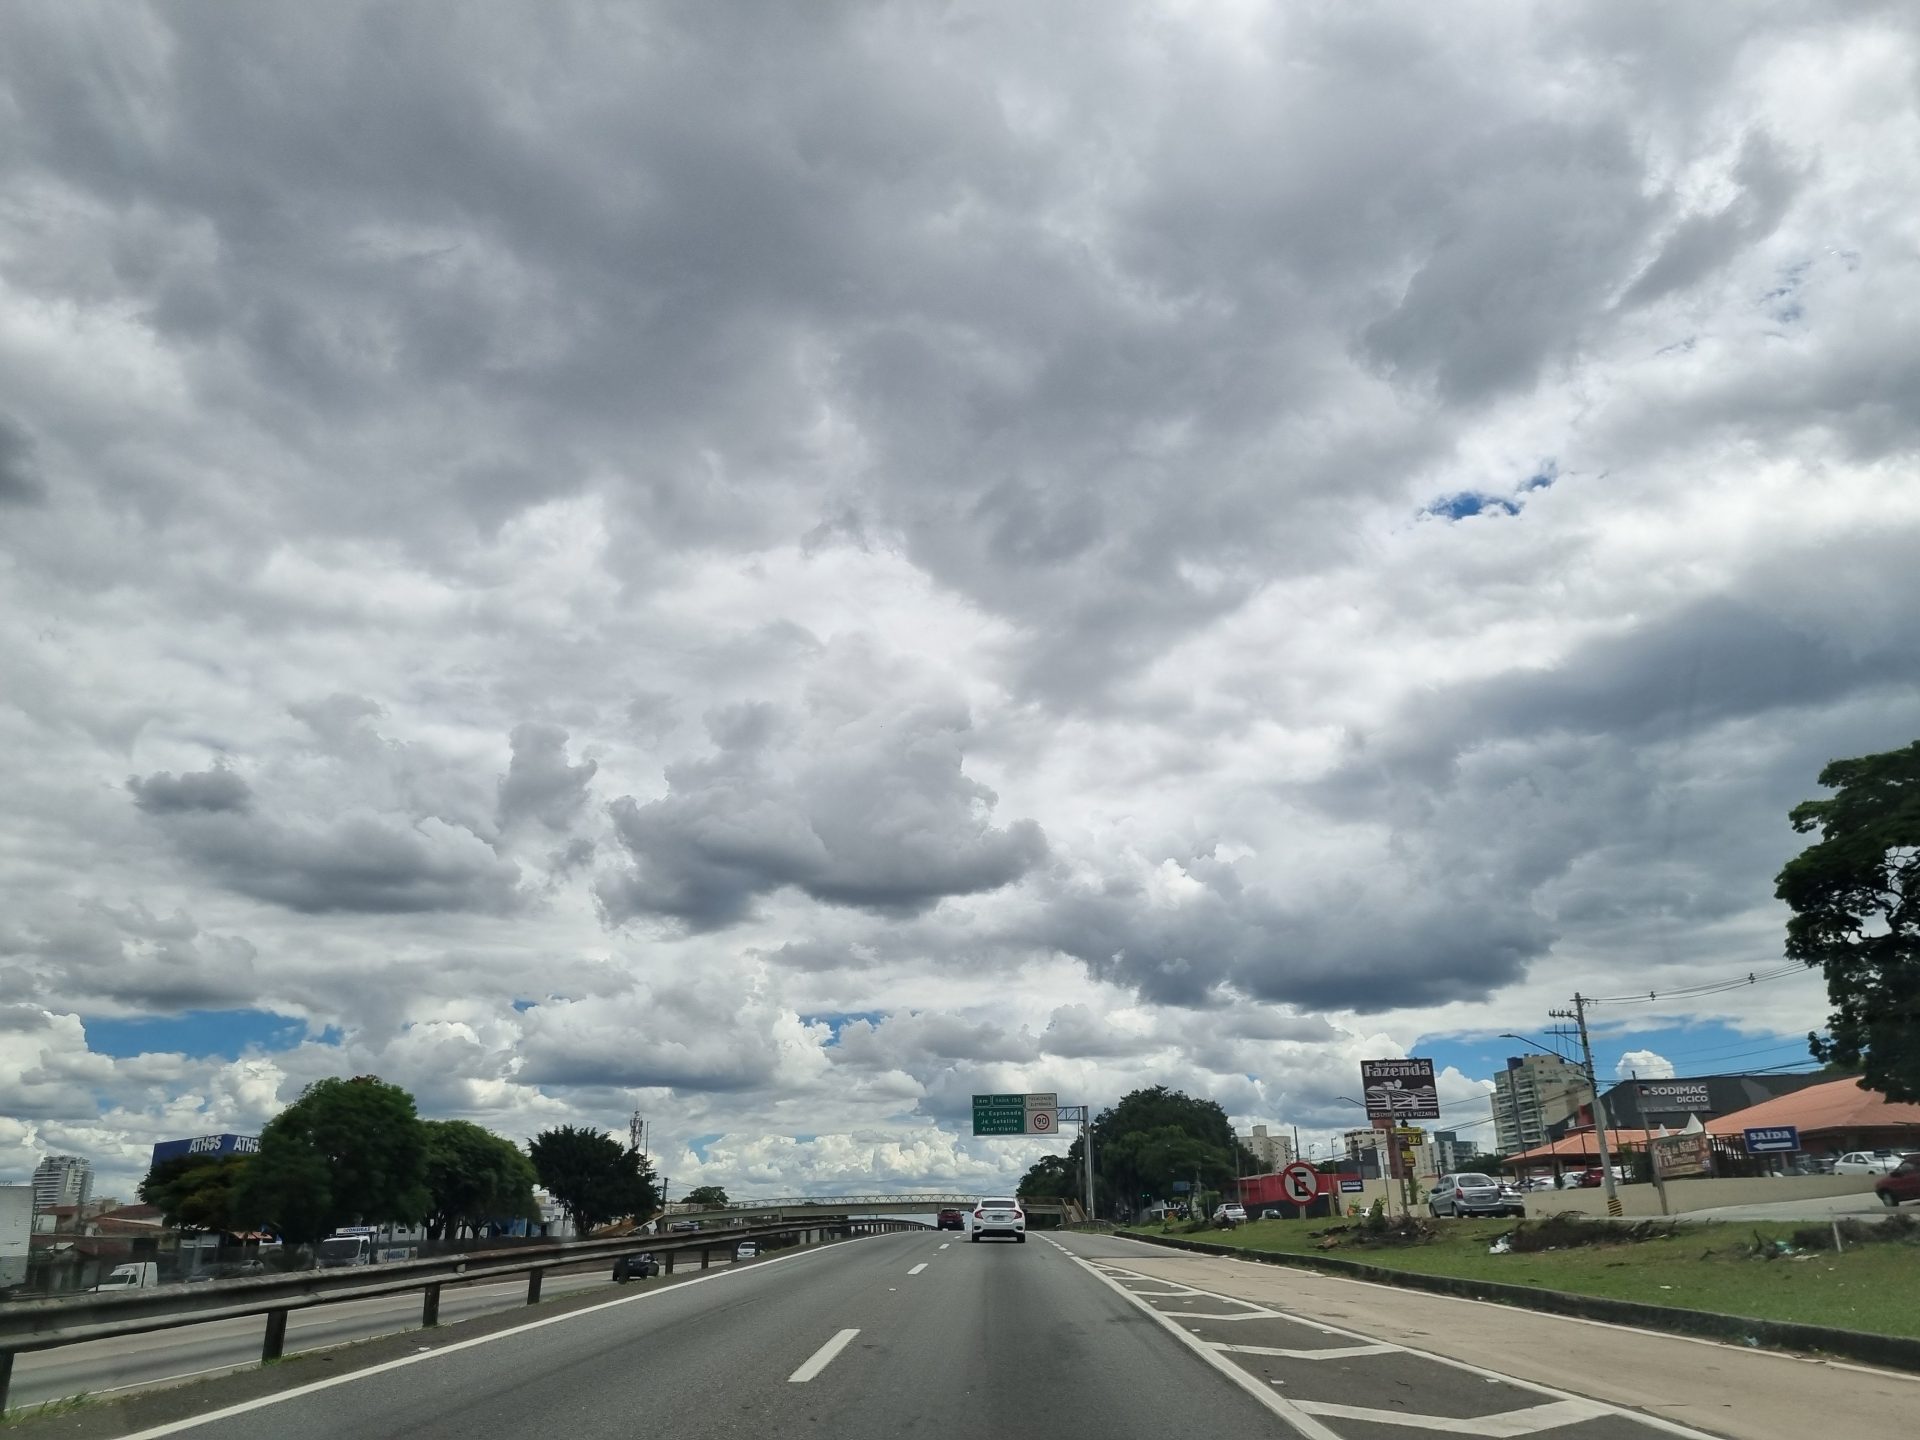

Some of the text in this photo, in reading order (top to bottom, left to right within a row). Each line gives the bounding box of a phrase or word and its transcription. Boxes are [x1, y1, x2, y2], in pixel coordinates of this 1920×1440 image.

[1363, 1064, 1431, 1077] Fazenda
[1651, 1085, 1708, 1096] SODIMAC
[1676, 1095, 1708, 1104] DICICO
[1036, 1117, 1047, 1125] 90
[1750, 1129, 1791, 1140] SAÍDA
[189, 1136, 222, 1153] ATHOS
[233, 1136, 261, 1152] ATHO
